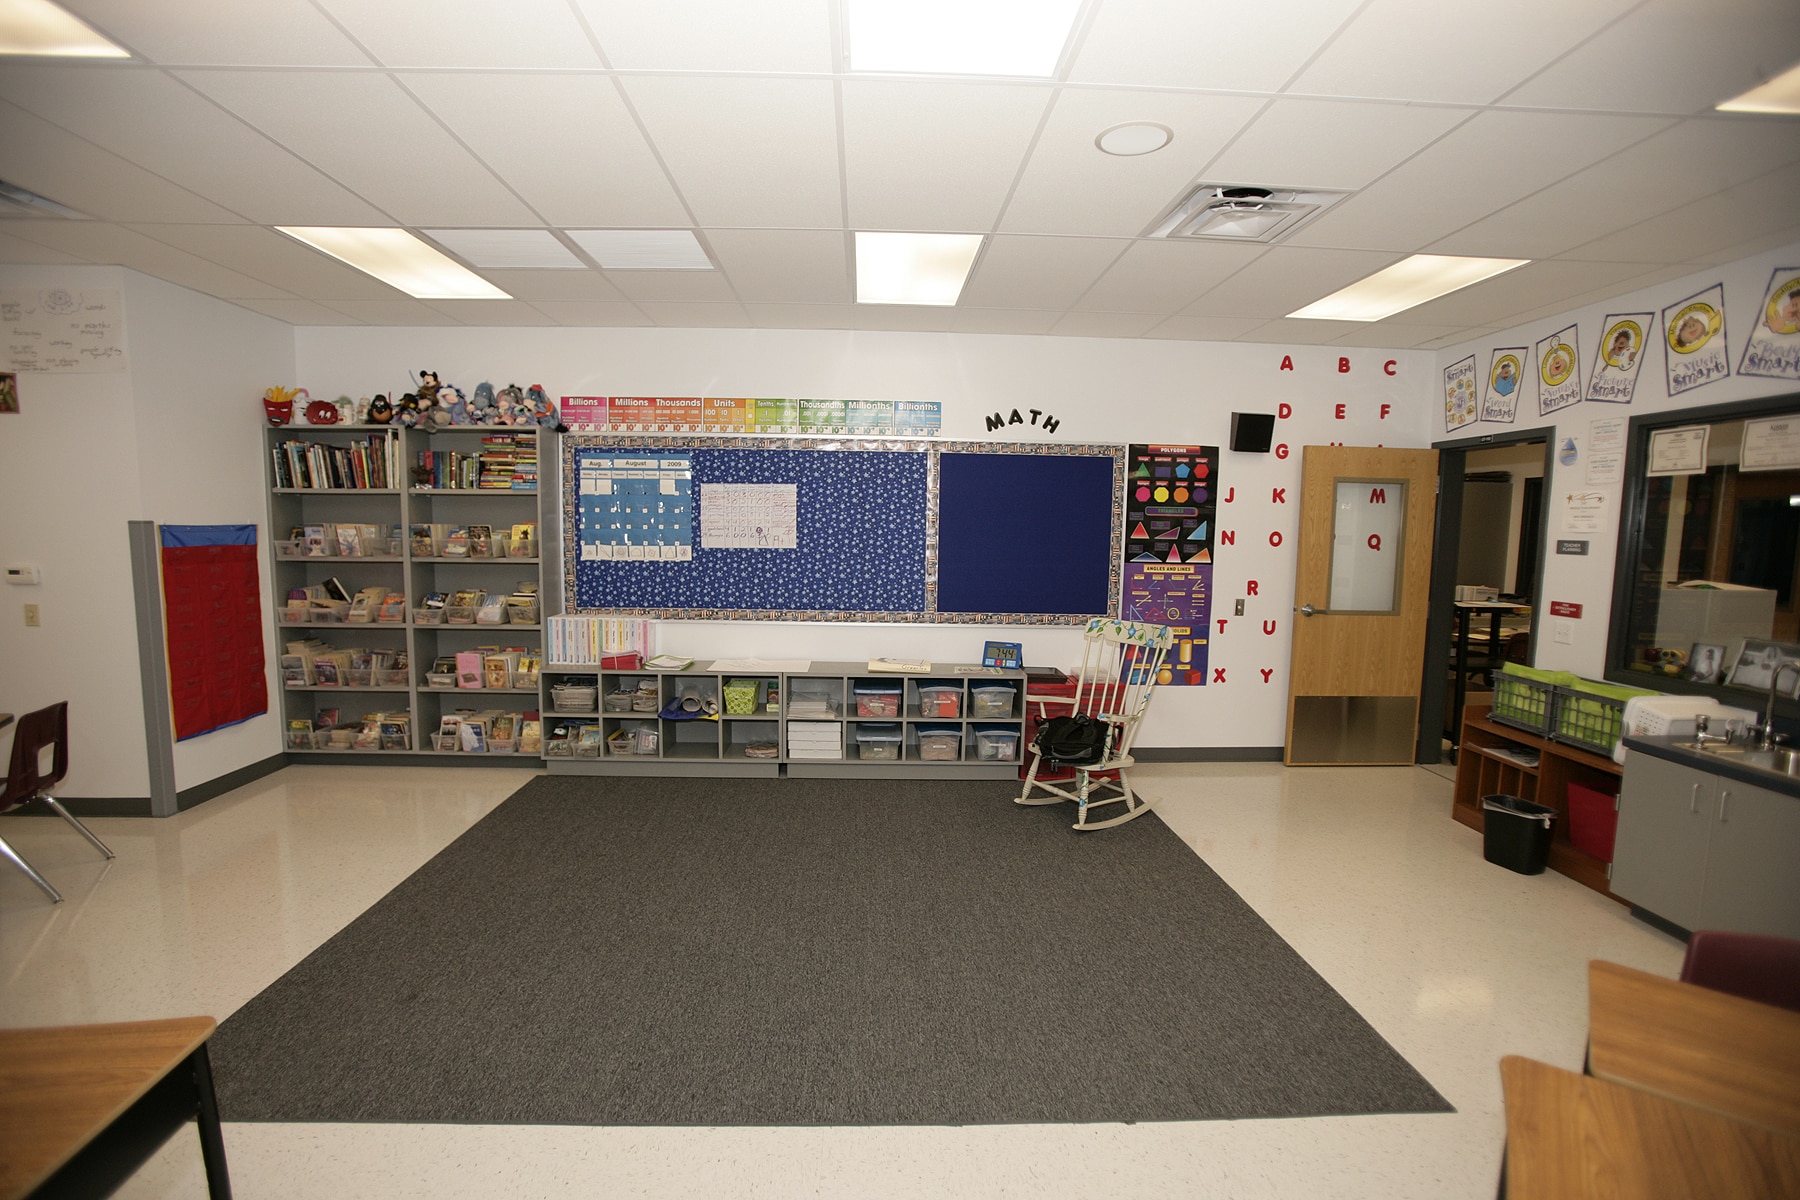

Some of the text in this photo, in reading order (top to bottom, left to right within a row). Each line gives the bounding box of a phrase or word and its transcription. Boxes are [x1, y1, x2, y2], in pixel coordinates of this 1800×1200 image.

[1279, 355, 1397, 376] A B C
[1447, 363, 1474, 385] Smart
[1673, 360, 1725, 391] Smart
[1590, 381, 1631, 398] Smart
[569, 398, 598, 406] Billions
[615, 398, 649, 406] Millions
[656, 398, 701, 407] Thousands
[714, 399, 736, 407] Units
[800, 401, 845, 409] Thousandths
[848, 402, 890, 411] Millionths
[898, 402, 938, 411] Billionths
[1543, 388, 1579, 412] Smart
[1278, 403, 1391, 420] D E F
[1484, 405, 1513, 419] Smart
[985, 408, 1060, 434] MATH
[1275, 443, 1289, 460] G
[1224, 487, 1386, 504] J K M
[1221, 530, 1382, 552] N O Q
[1247, 580, 1259, 596] R
[1217, 619, 1276, 636] T U
[1213, 667, 1274, 684] X Y
